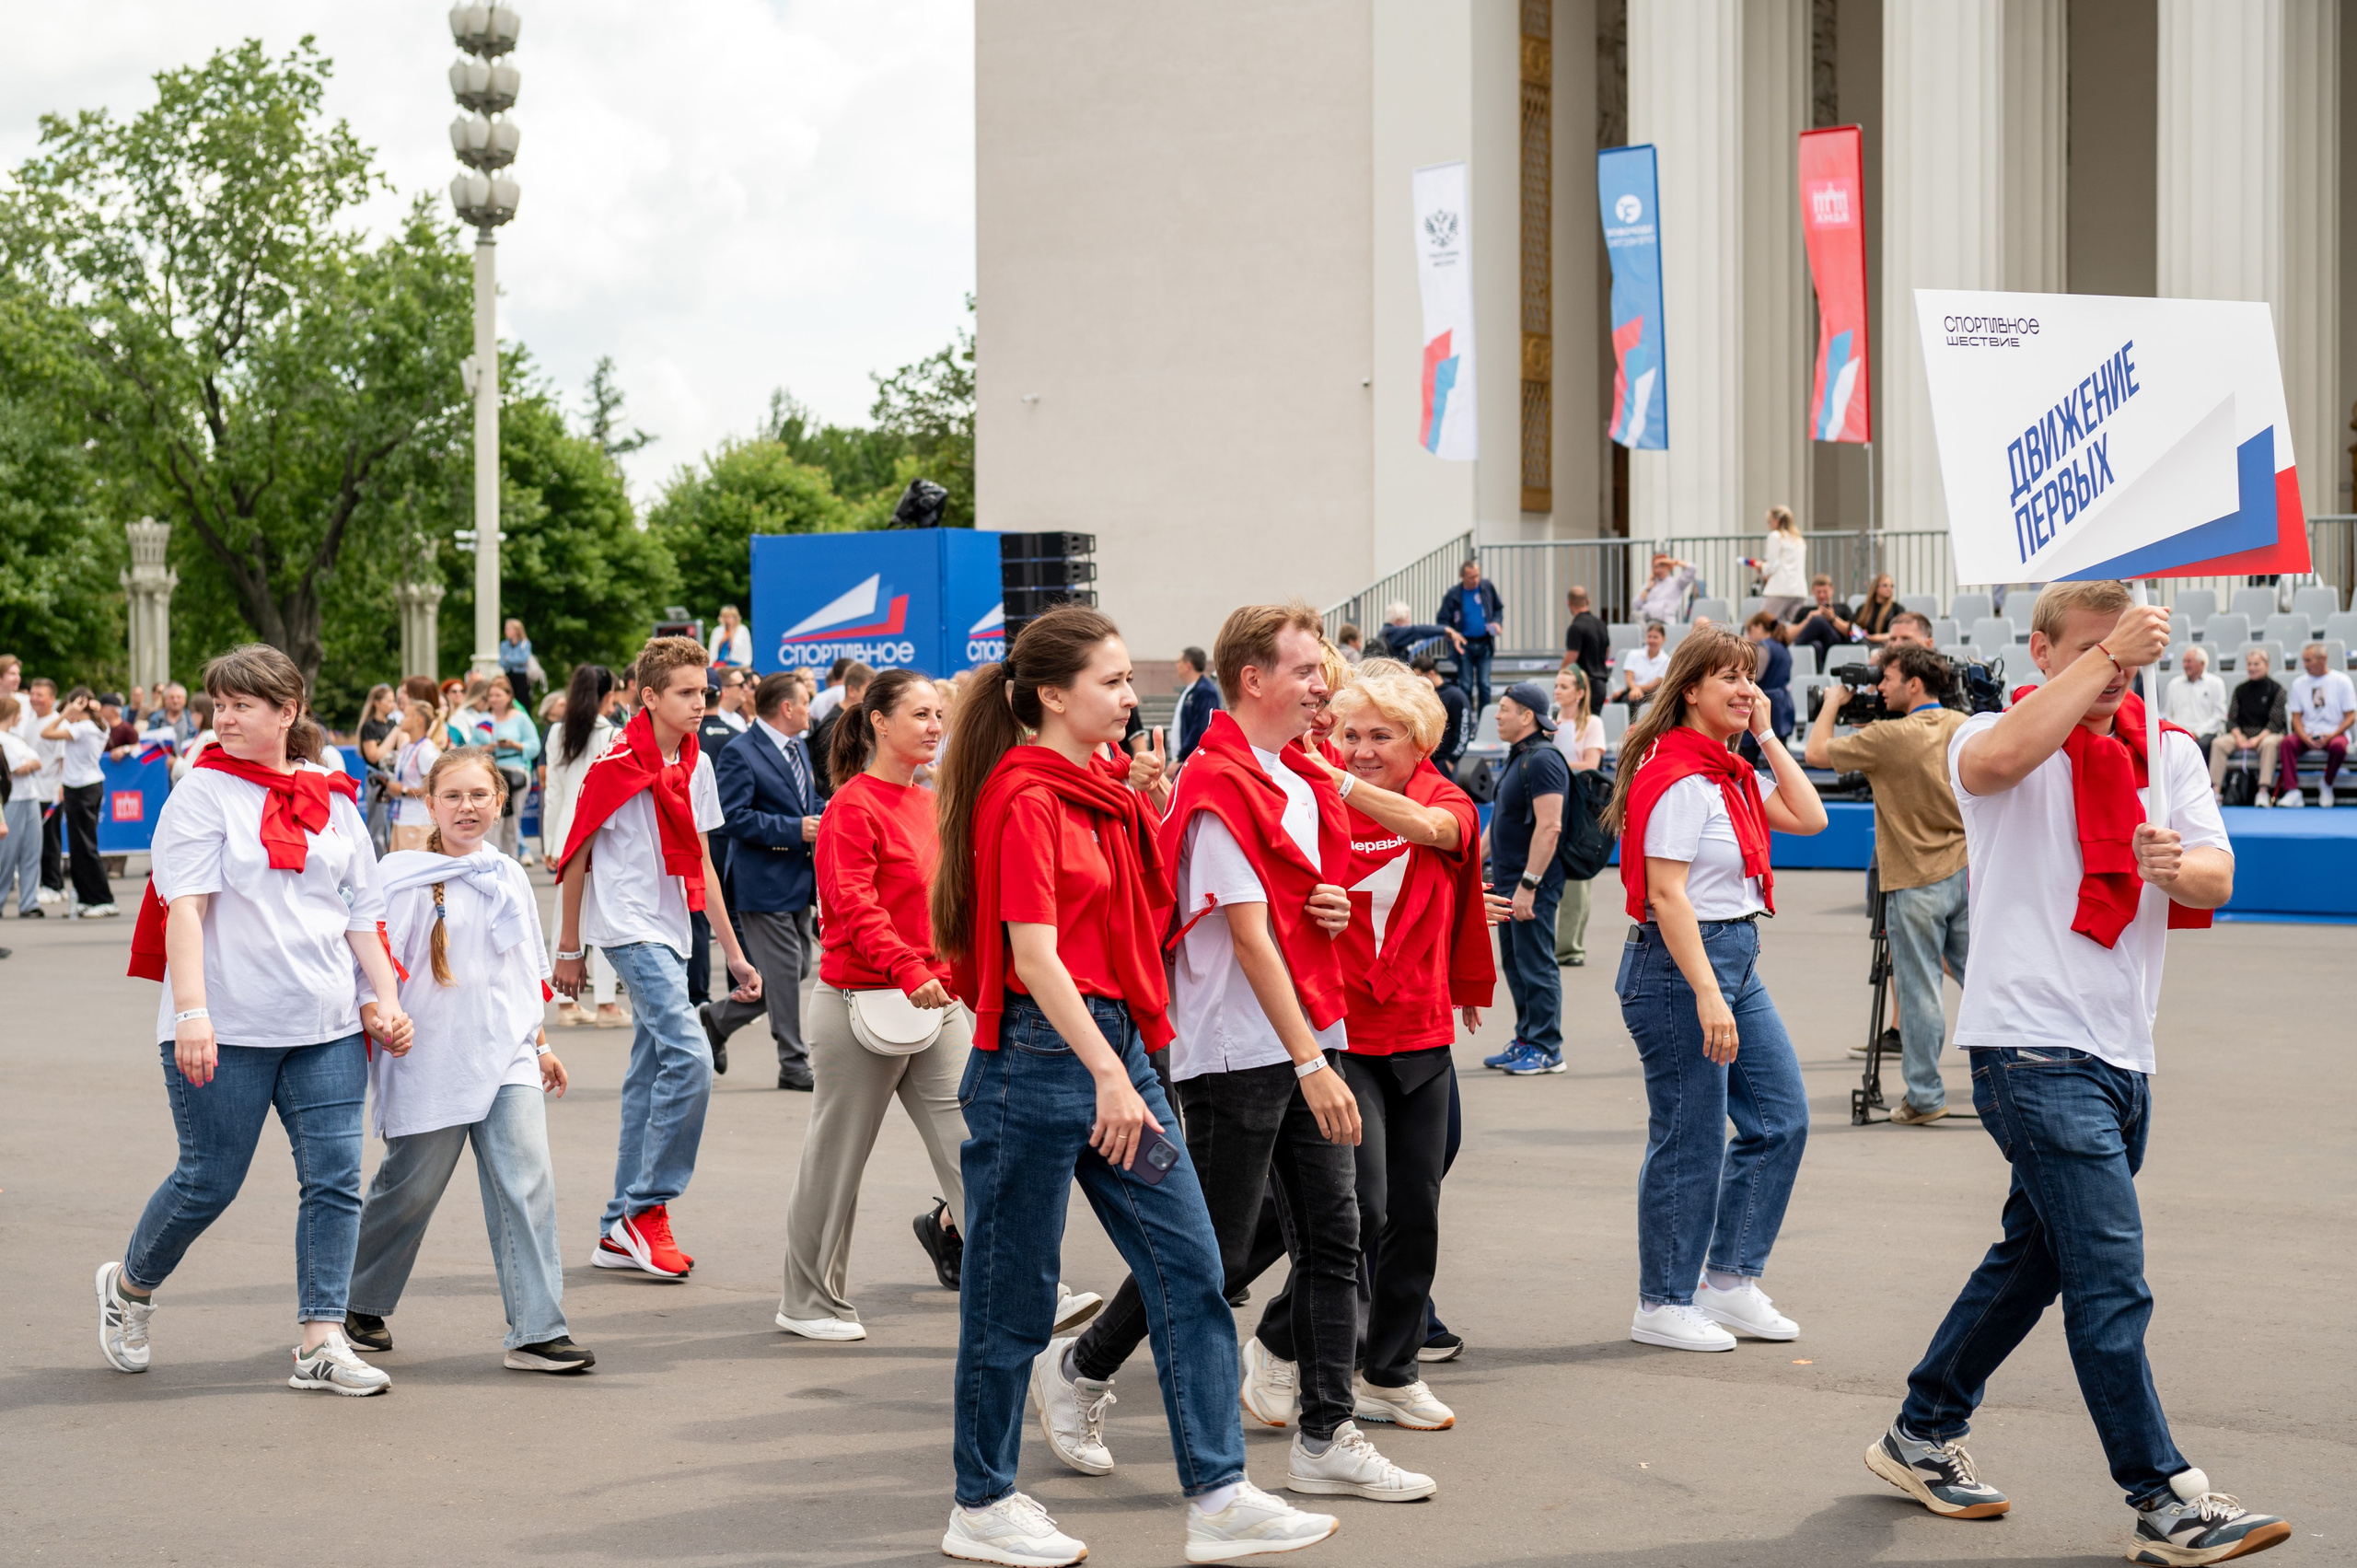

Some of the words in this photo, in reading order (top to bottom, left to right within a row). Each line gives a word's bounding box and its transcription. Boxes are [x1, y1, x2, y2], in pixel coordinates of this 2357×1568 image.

[1946, 336, 2020, 347] ШЕСТВИЕ
[2007, 339, 2141, 508] ДВИЖЕНИЕ
[2014, 431, 2115, 564] ПЕРВЫХ
